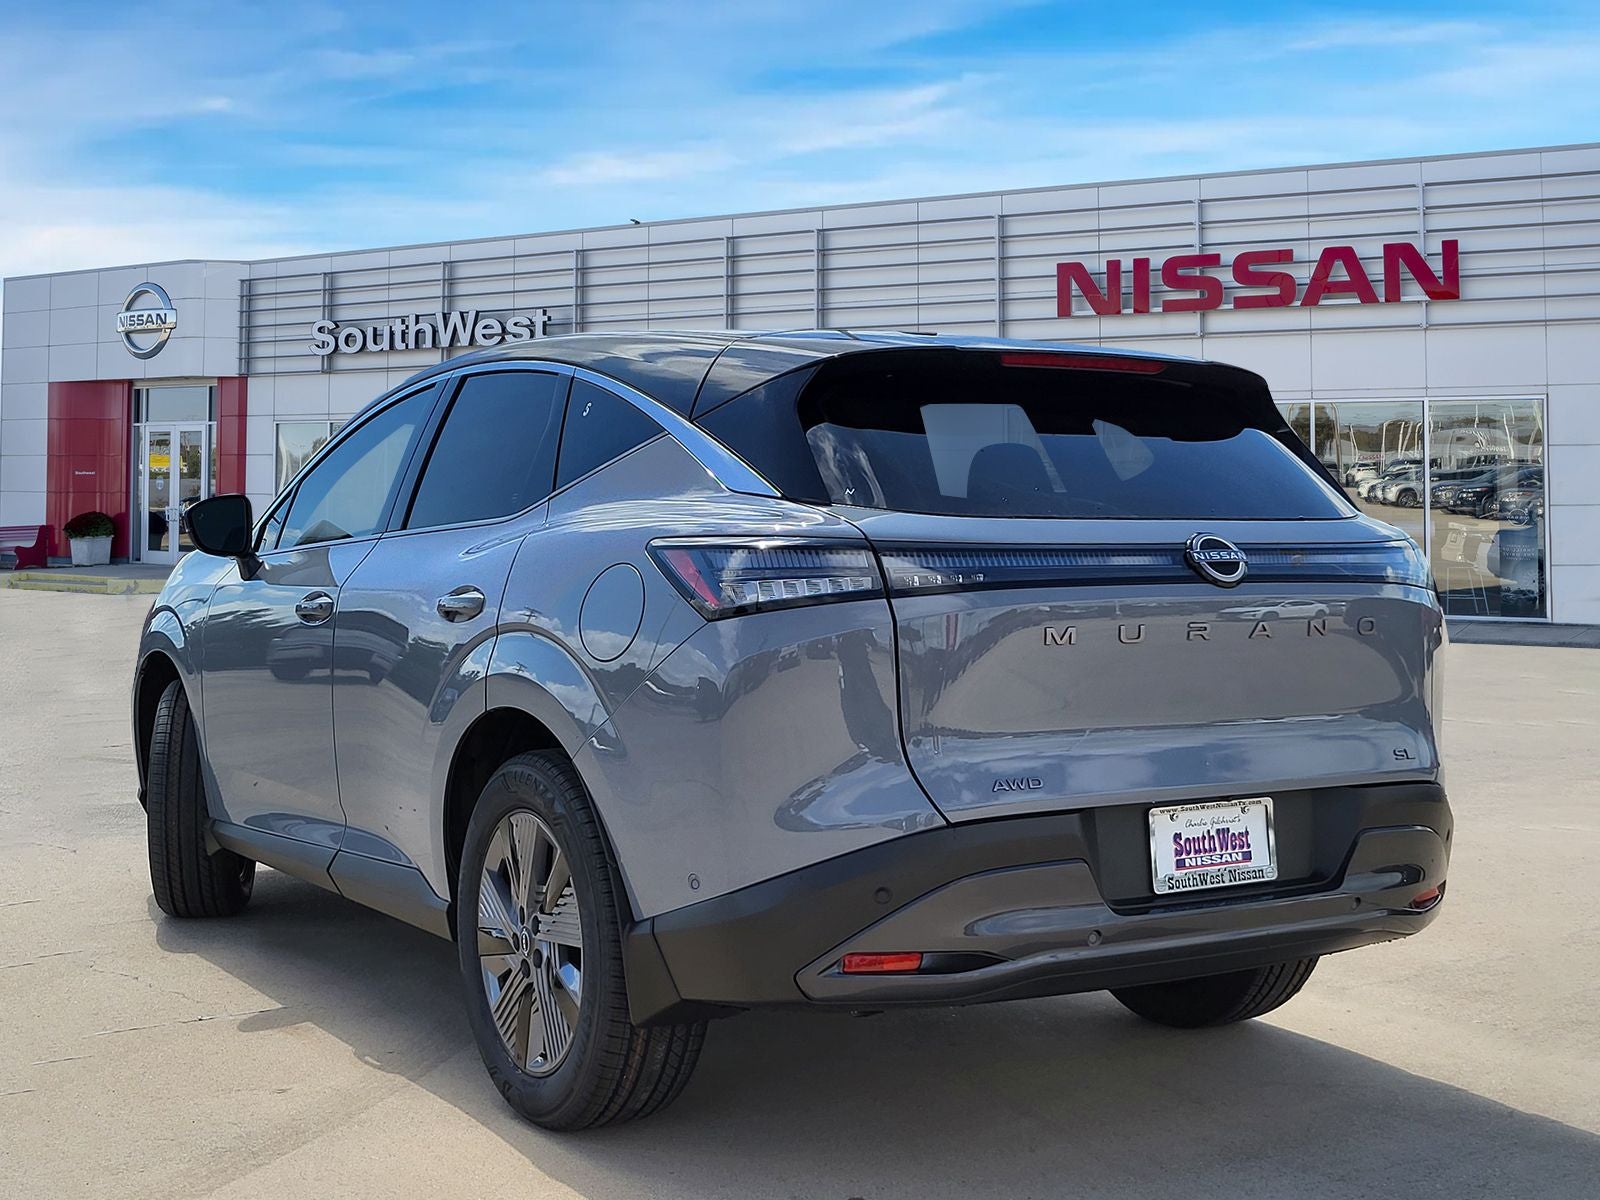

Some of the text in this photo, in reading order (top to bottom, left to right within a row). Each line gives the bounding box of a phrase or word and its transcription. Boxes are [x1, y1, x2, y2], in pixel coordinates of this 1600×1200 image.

[1056, 239, 1460, 318] NISSAN
[119, 312, 167, 328] NISSAN
[308, 309, 550, 356] SouthWest
[1193, 551, 1247, 560] NISSAN
[1043, 616, 1376, 646] MURANO
[1393, 748, 1416, 761] SL
[992, 777, 1044, 792] AWD
[1173, 826, 1251, 857] SouthWest
[1185, 852, 1242, 866] NISSAN
[1167, 870, 1226, 890] SouthWest
[1228, 867, 1265, 882] Nissan
